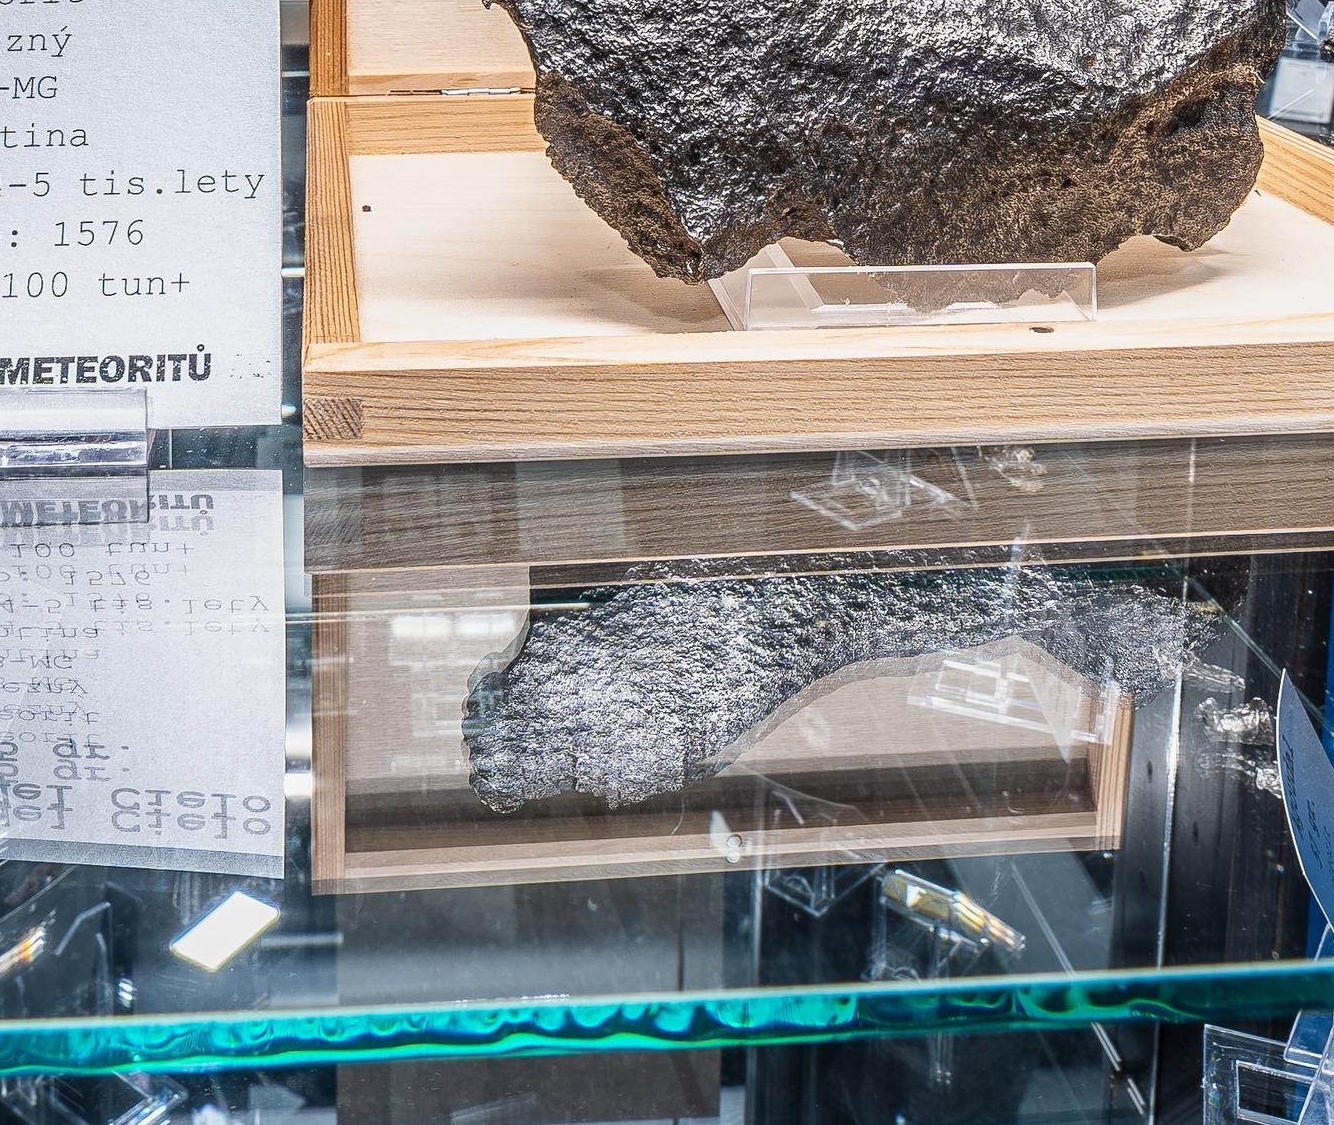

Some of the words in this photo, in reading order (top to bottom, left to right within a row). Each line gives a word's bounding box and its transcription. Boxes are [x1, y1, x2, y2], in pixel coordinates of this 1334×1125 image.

[80, 169, 266, 199] tis.lety
[52, 220, 144, 247] 1576
[1, 272, 69, 299] 100
[98, 272, 190, 298] tun+
